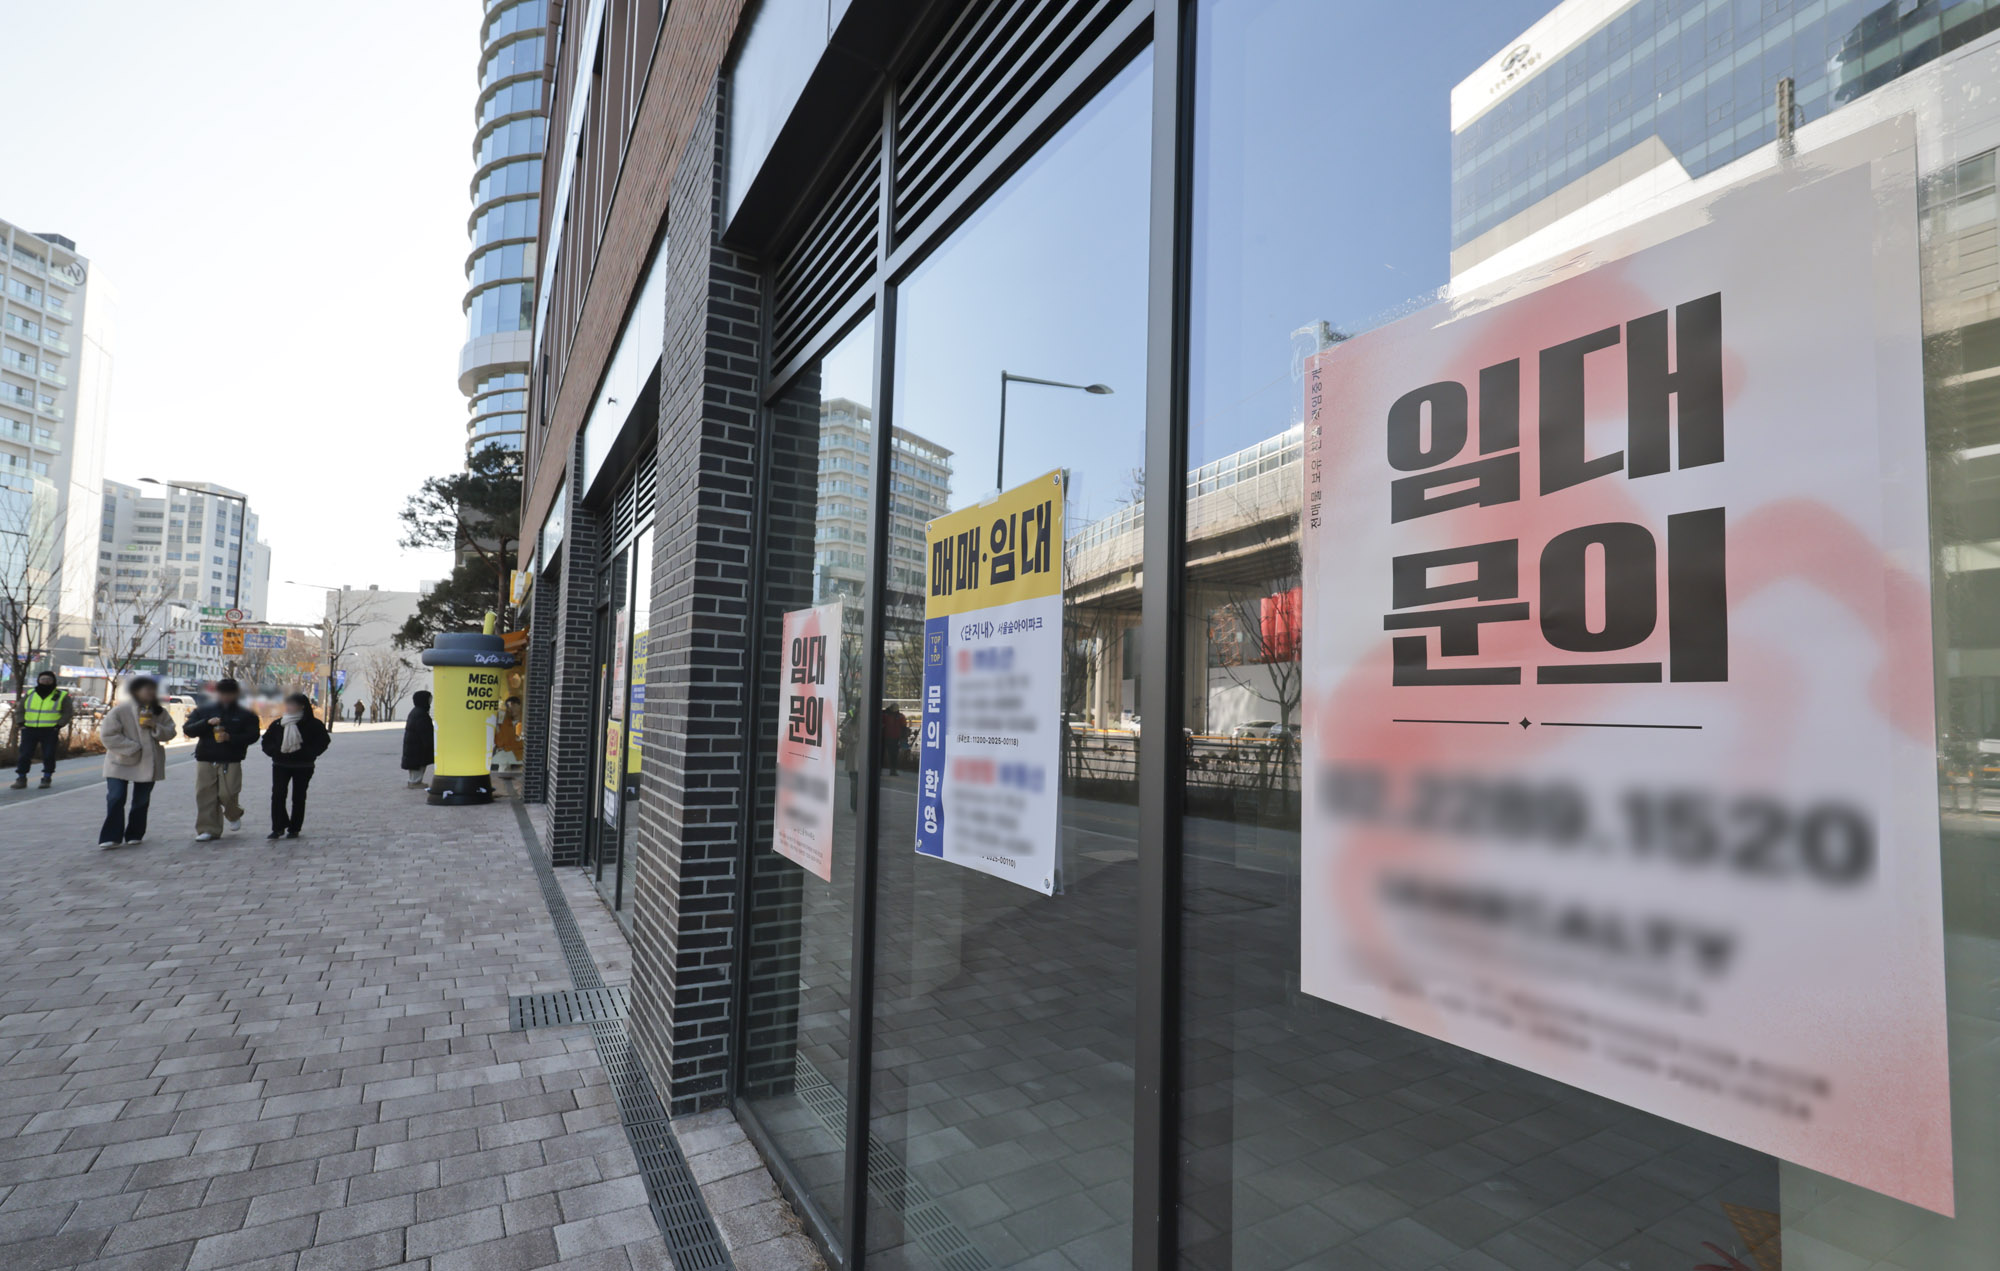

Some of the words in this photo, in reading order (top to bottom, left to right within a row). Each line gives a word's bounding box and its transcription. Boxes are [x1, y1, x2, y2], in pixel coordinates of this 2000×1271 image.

[1387, 291, 1725, 524] 임대
[931, 500, 1052, 597] 매매·임대
[1384, 506, 1728, 687] 문의
[930, 636, 941, 645] TOP
[997, 616, 1043, 635] 서울숲아이파크
[791, 634, 828, 685] 임대
[930, 654, 941, 663] TOP
[467, 686, 493, 698] MGC
[468, 673, 499, 686] MEGA
[788, 695, 824, 748] 문의
